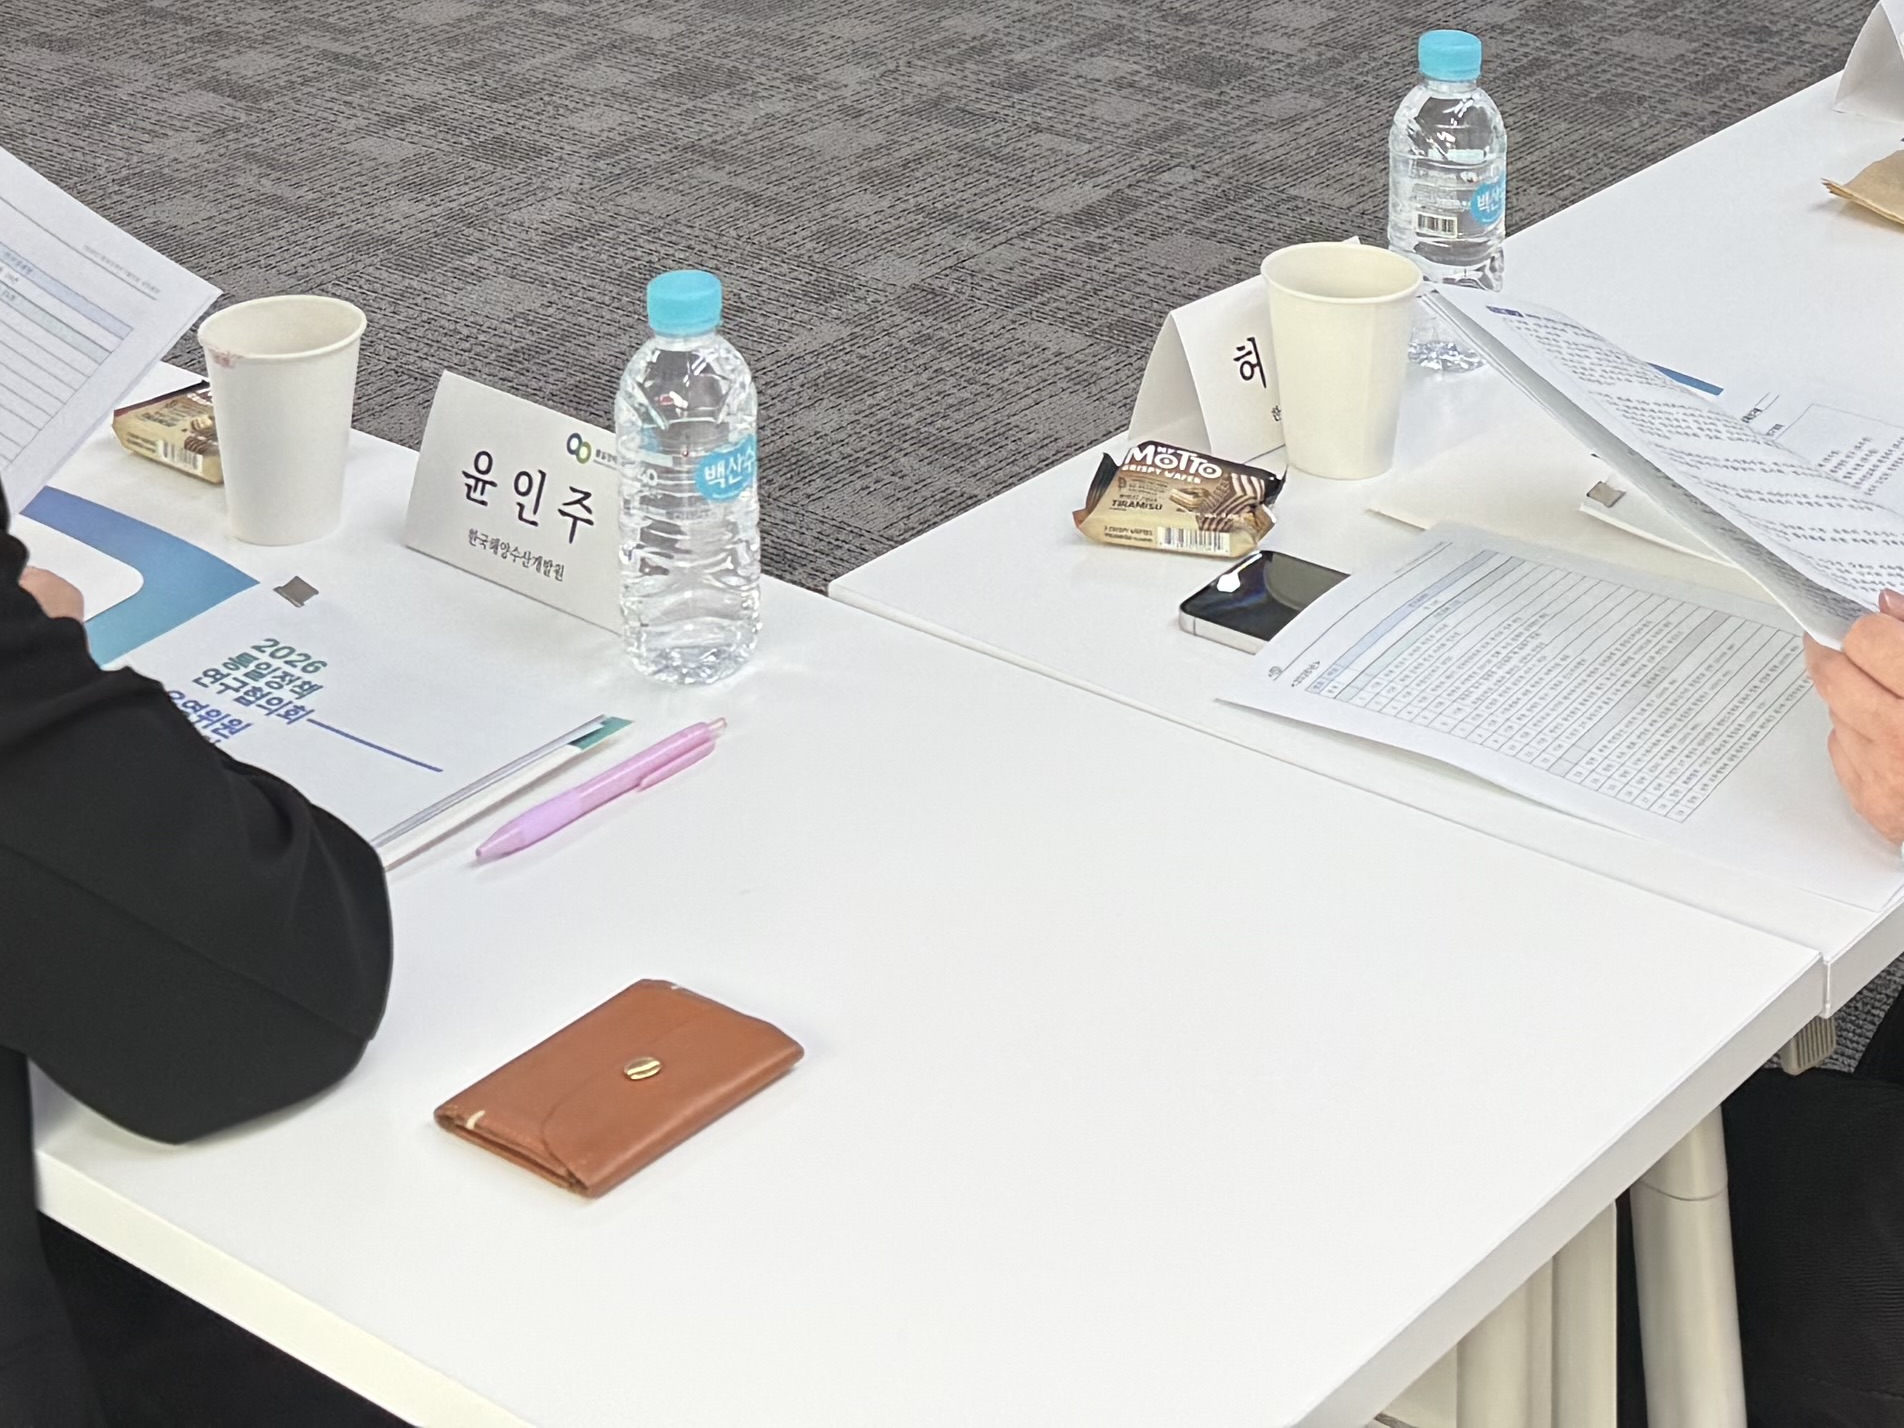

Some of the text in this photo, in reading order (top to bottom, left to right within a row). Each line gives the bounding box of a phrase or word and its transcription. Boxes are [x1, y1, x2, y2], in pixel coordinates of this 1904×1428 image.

[462, 450, 594, 545] 윤인주
[1121, 463, 1202, 485] CRISPY WAFER
[1112, 499, 1163, 511] TIRAMISU
[468, 528, 565, 582] 한국해양수산개발원
[222, 652, 324, 700] 통일정책
[251, 638, 328, 674] 2026
[192, 668, 315, 725] 연구협의회
